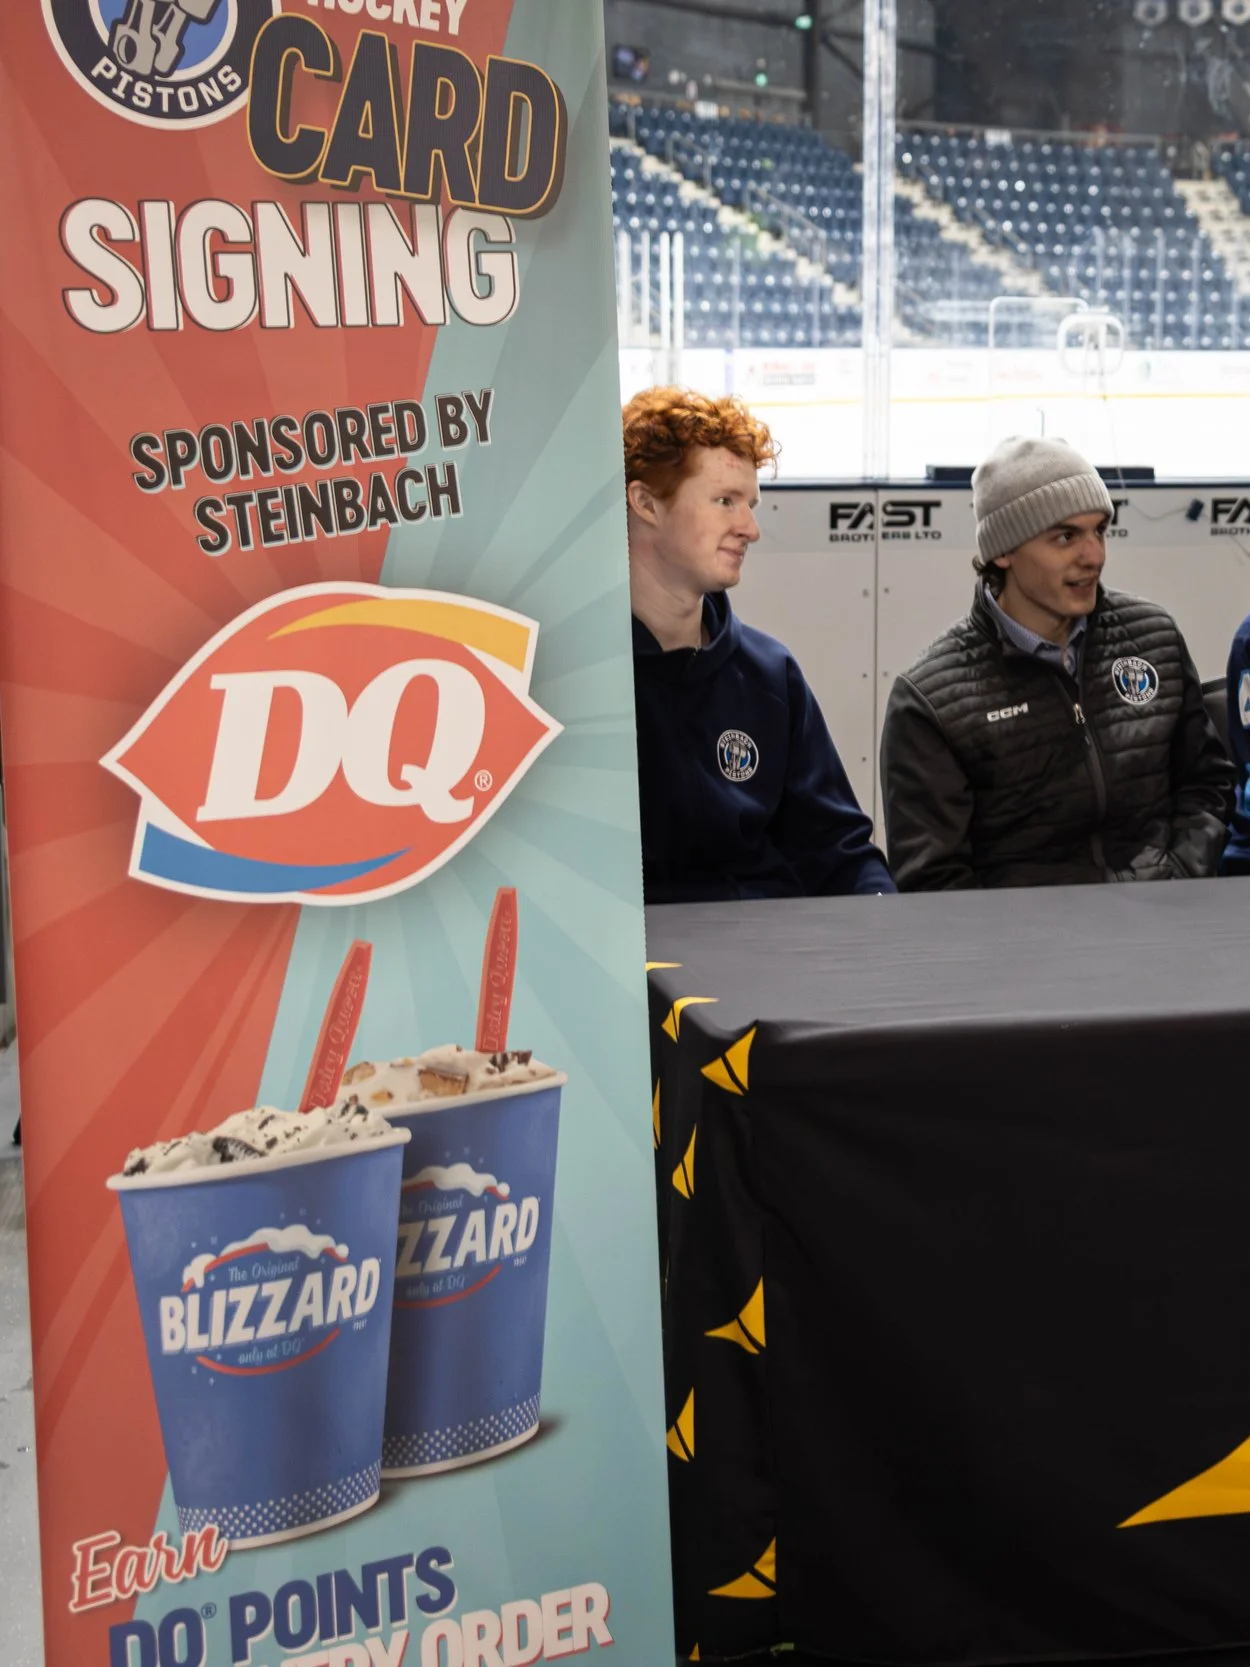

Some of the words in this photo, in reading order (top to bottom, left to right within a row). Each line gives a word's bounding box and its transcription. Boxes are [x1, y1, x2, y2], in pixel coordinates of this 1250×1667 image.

[90, 56, 243, 113] PISTONS
[247, 13, 564, 217] CARD
[59, 197, 519, 333] SIGNING
[130, 397, 428, 494] SPONSORED
[434, 387, 495, 452] BY
[194, 460, 464, 557] STEINBACH
[829, 500, 942, 530] FAST
[986, 702, 1029, 722] CCM
[159, 1257, 381, 1355] BLIZZARD
[228, 1265, 248, 1283] The
[251, 1255, 301, 1280] Original
[238, 1347, 264, 1366] only
[68, 1522, 229, 1614] Earn
[230, 1546, 457, 1663] POINTS
[421, 1582, 614, 1667] ORDER
